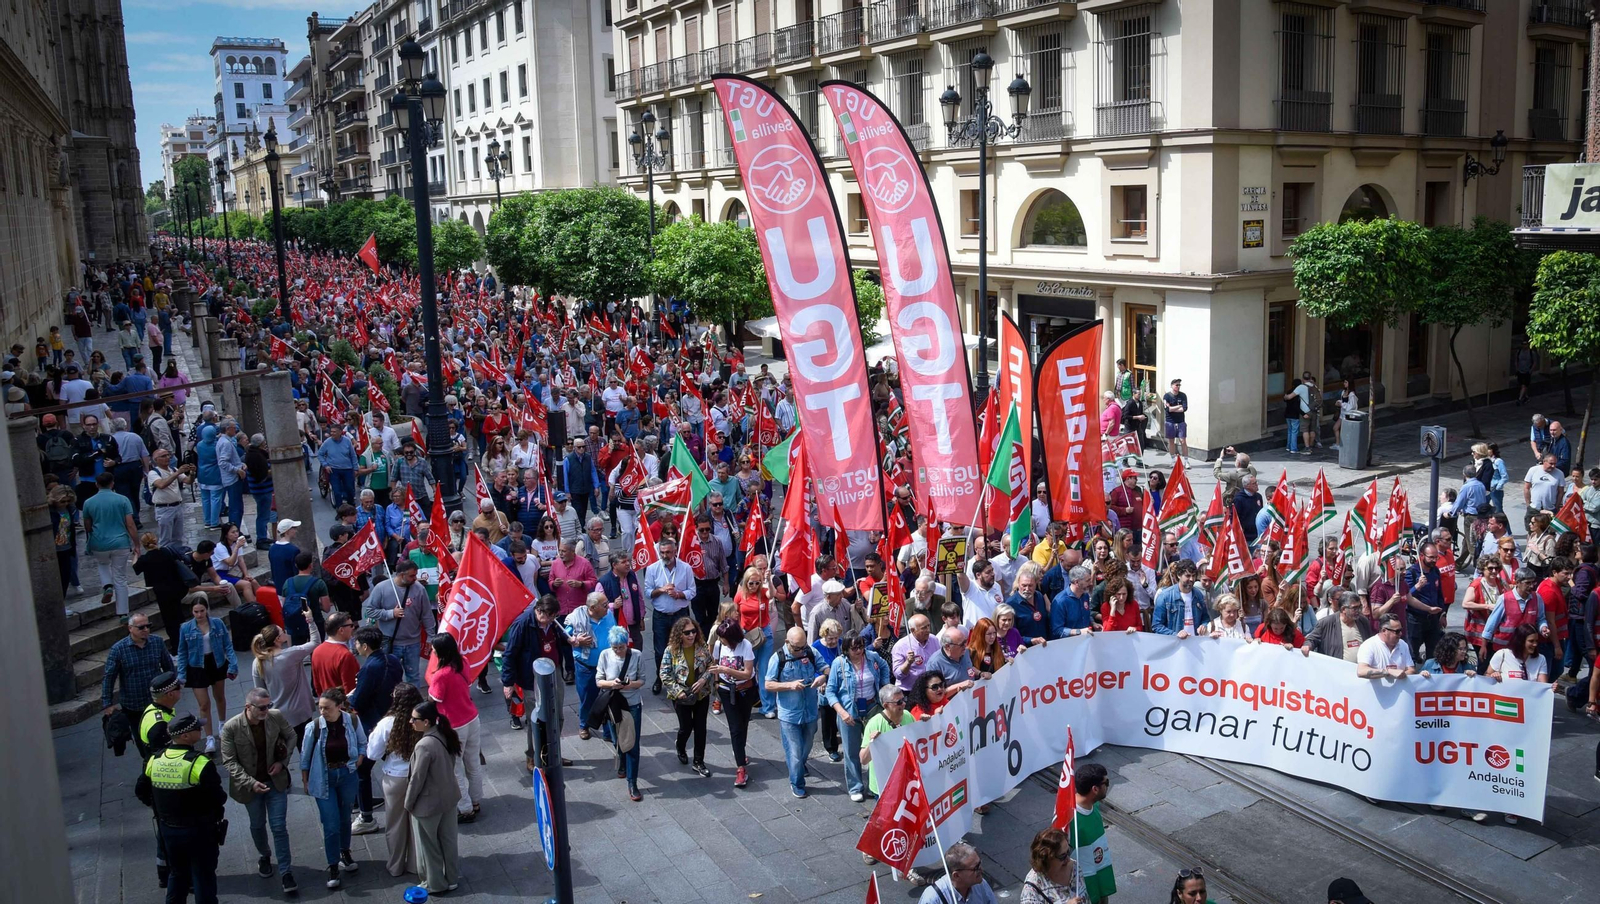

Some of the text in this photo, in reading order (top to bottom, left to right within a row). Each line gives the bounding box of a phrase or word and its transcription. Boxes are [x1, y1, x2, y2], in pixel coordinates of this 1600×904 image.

[972, 686, 987, 719] 1
[1020, 670, 1130, 714] Proteger
[1142, 665, 1170, 692] lo
[1178, 675, 1374, 739] conquistado,
[1420, 696, 1490, 714] CCOO
[1415, 719, 1450, 729] Sevilla
[897, 731, 943, 764] GT
[1144, 706, 1372, 772] ganar futuro
[1415, 741, 1478, 766] UGT
[1468, 771, 1525, 787] Andalucía
[1492, 785, 1525, 798] Sevilla
